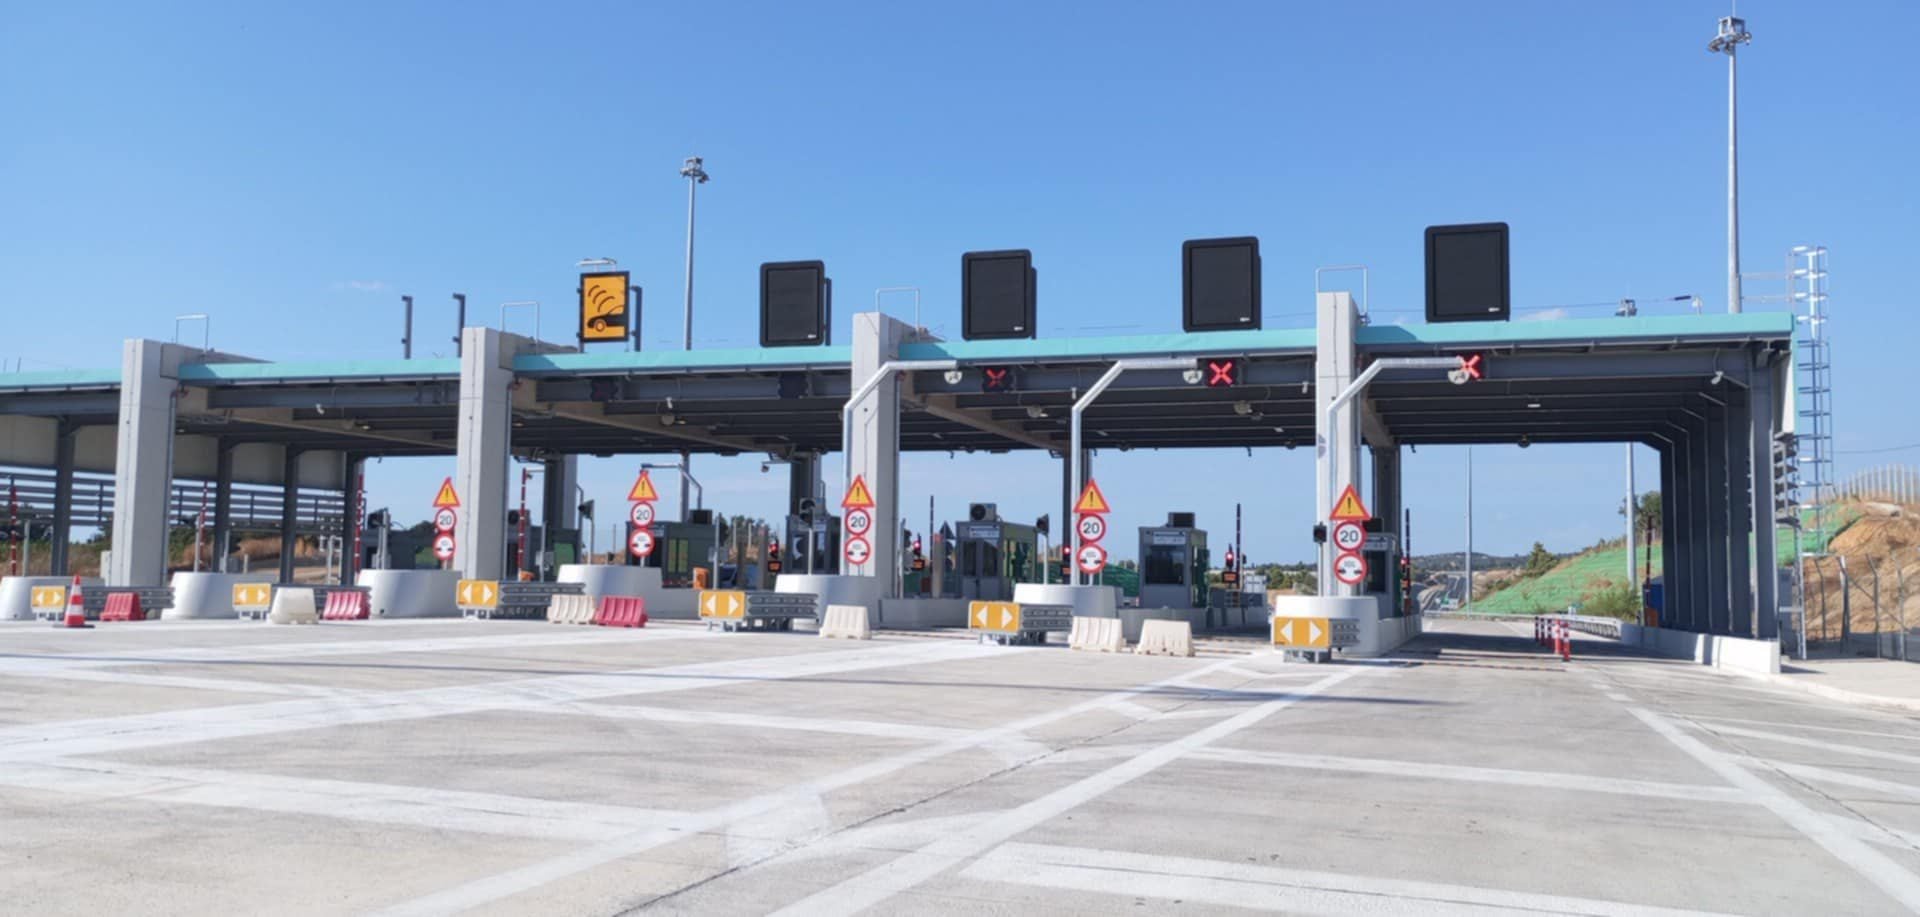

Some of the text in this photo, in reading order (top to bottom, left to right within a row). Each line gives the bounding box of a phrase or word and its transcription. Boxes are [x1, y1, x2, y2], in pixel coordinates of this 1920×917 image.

[439, 515, 451, 525] 20
[636, 509, 649, 520] 20
[851, 516, 865, 528] 20
[1083, 522, 1099, 534] 20
[1340, 530, 1359, 543] 20
